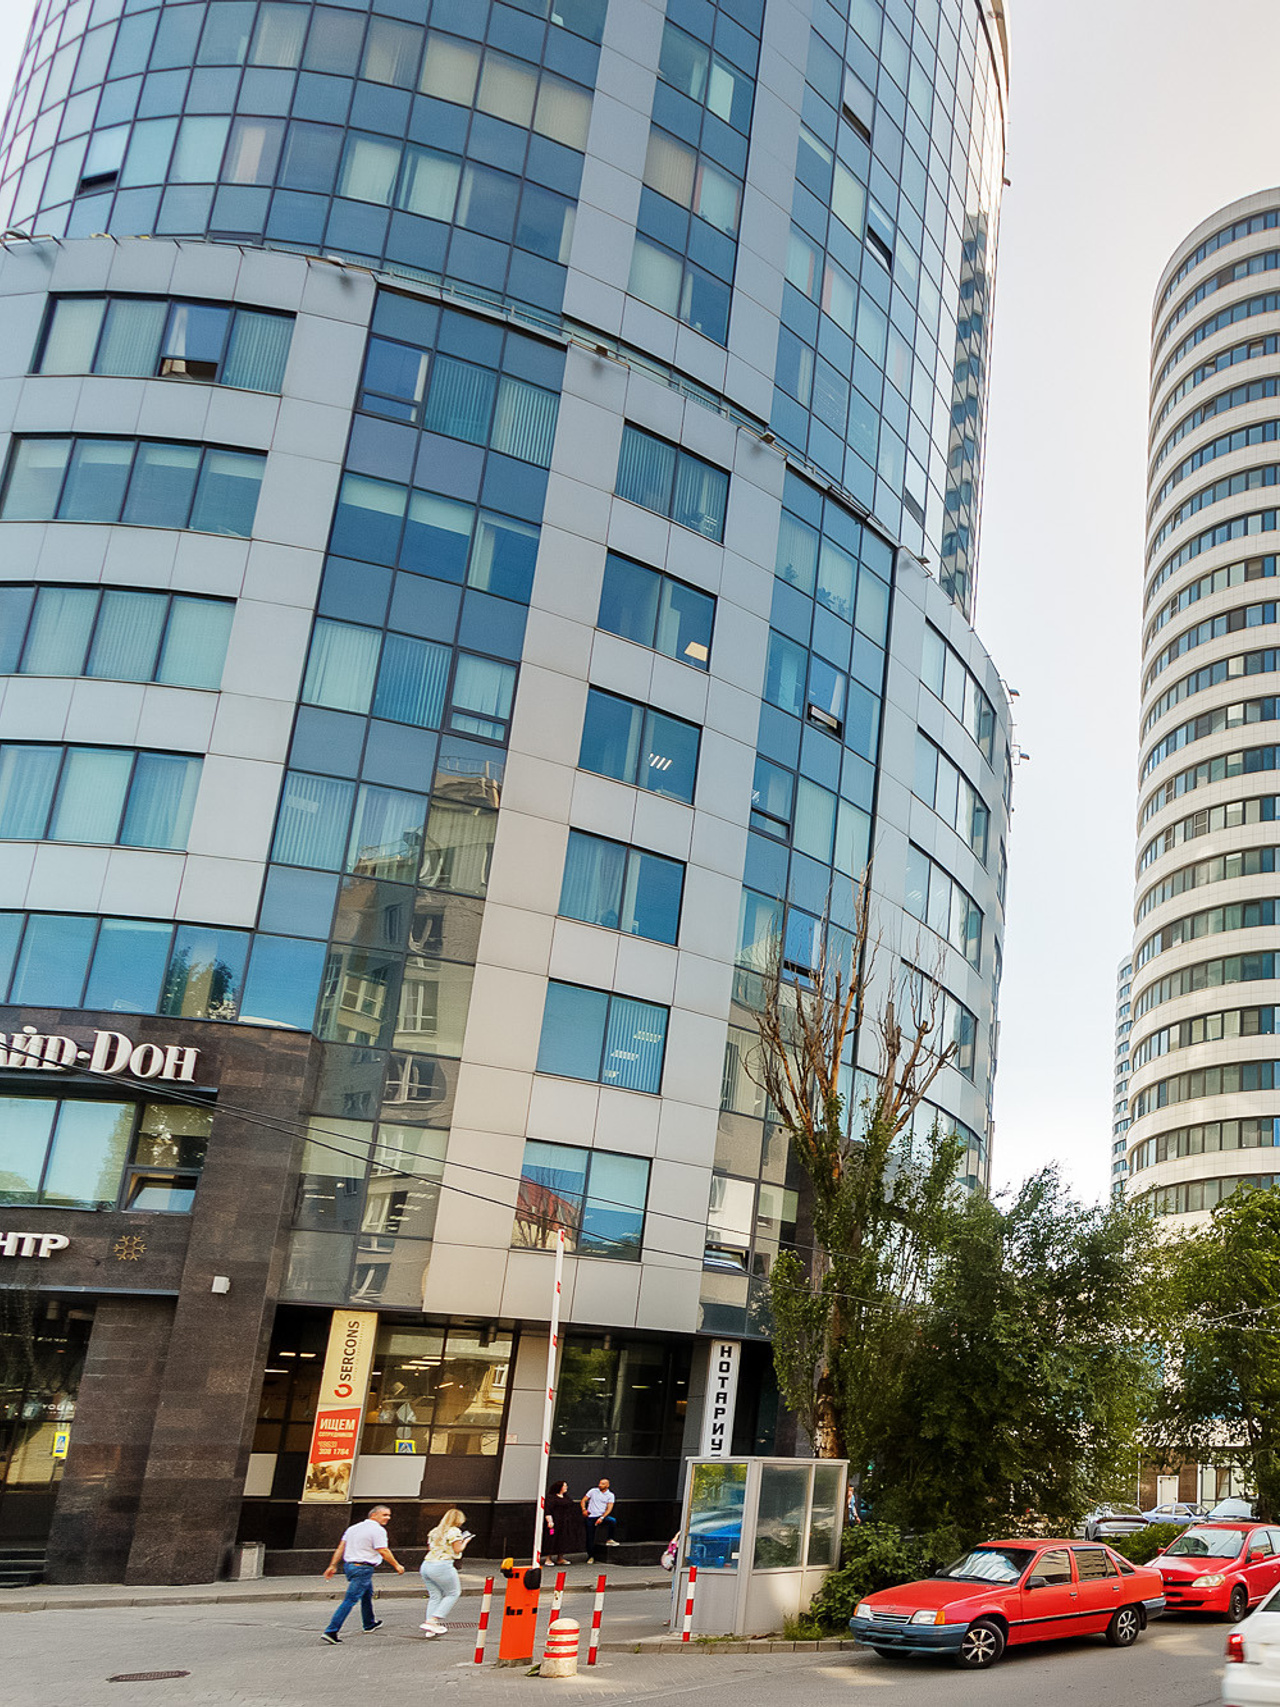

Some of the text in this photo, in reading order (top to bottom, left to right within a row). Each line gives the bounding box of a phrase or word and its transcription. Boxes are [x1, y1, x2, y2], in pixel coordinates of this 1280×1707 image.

[340, 1320, 360, 1382] SERCONS
[320, 1418, 356, 1431] ИЩЕМ
[710, 1345, 732, 1457] НОТАРИУ
